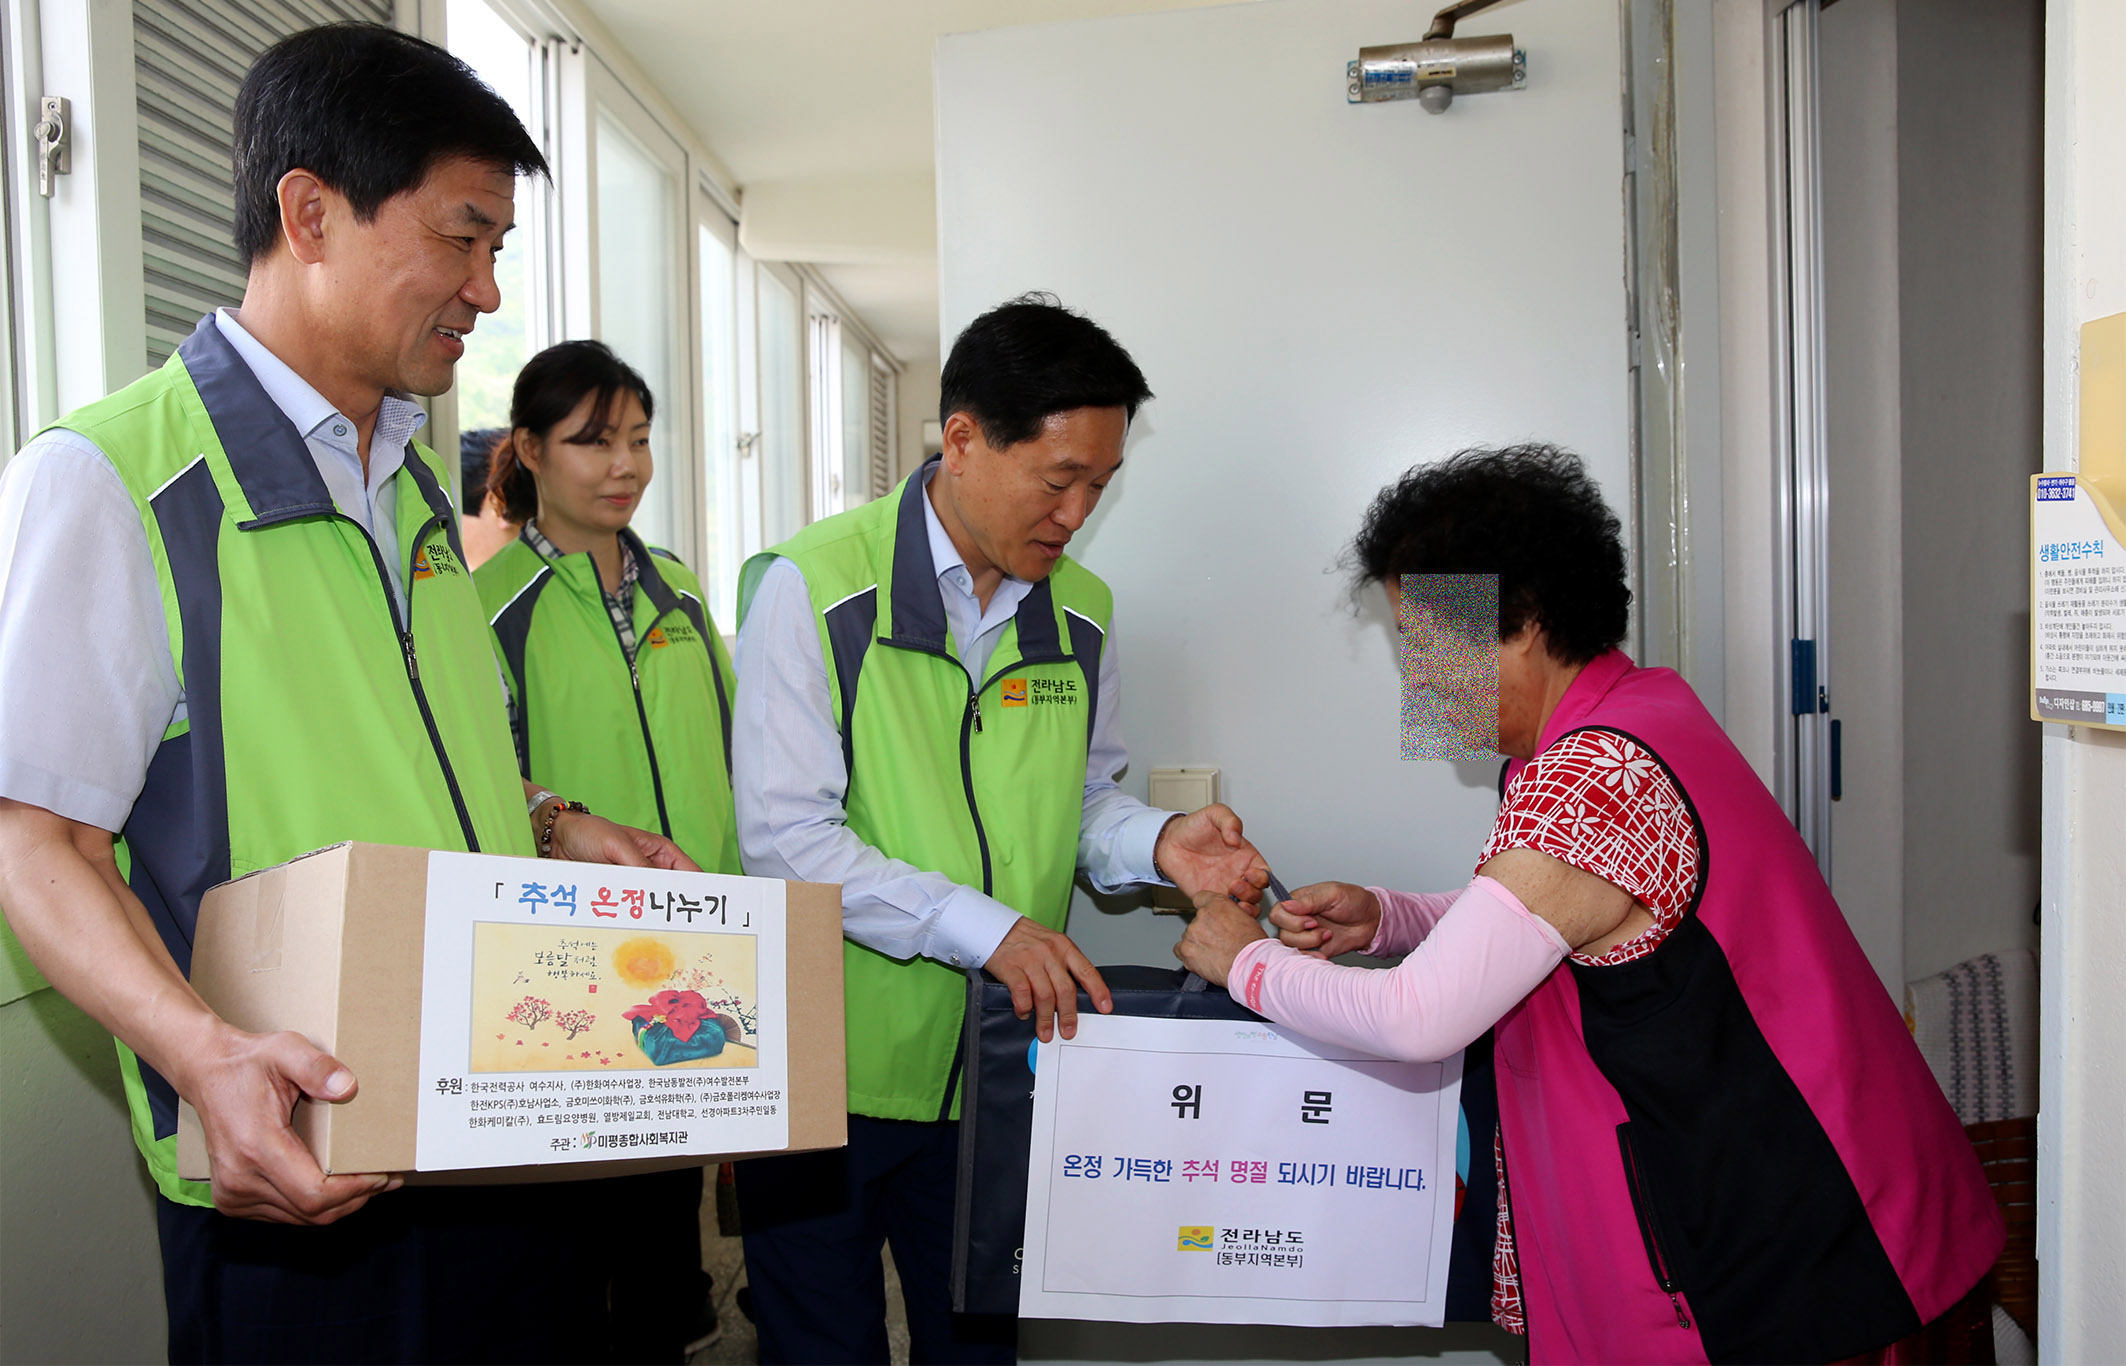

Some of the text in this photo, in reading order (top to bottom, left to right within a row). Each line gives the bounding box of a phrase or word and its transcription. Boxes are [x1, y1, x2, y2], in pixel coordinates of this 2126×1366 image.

[2039, 540, 2104, 562] 생활안전수칙
[1031, 679, 1077, 693] 전라남도
[1031, 695, 1077, 705] (동부지역본부)
[518, 881, 578, 917] 추석
[590, 886, 728, 926] 온정나누기
[558, 938, 599, 951] 추석에는
[547, 969, 602, 981] 행복하세요.
[470, 1080, 524, 1093] 한국전력공사
[530, 1080, 566, 1092] 여수지사,
[571, 1078, 645, 1091] (주)한화여수사업장,
[648, 1075, 749, 1089] 한국남동발전(주)여수발전본부
[470, 1097, 562, 1112] 한전KPS(주)호남사업소,
[565, 1094, 636, 1109] 금호미쓰이화학(주),
[639, 1092, 697, 1105] 금호석유화학(주),
[1170, 1084, 1333, 1125] 위 문
[468, 1105, 777, 1129] 한화케미칼(주), 효드림요양병원, 열방제일교회, 전남대학교, 선경아파트3차주민일동
[598, 1131, 688, 1148] 미평종합사회복지관
[1063, 1154, 1427, 1192] 온정 가득한 추석 명절 되시기 바랍니다.
[1220, 1228, 1304, 1245] 전라남도
[1221, 1243, 1304, 1253] JeollaNamdo
[1216, 1251, 1303, 1269] [동부지역본부]
